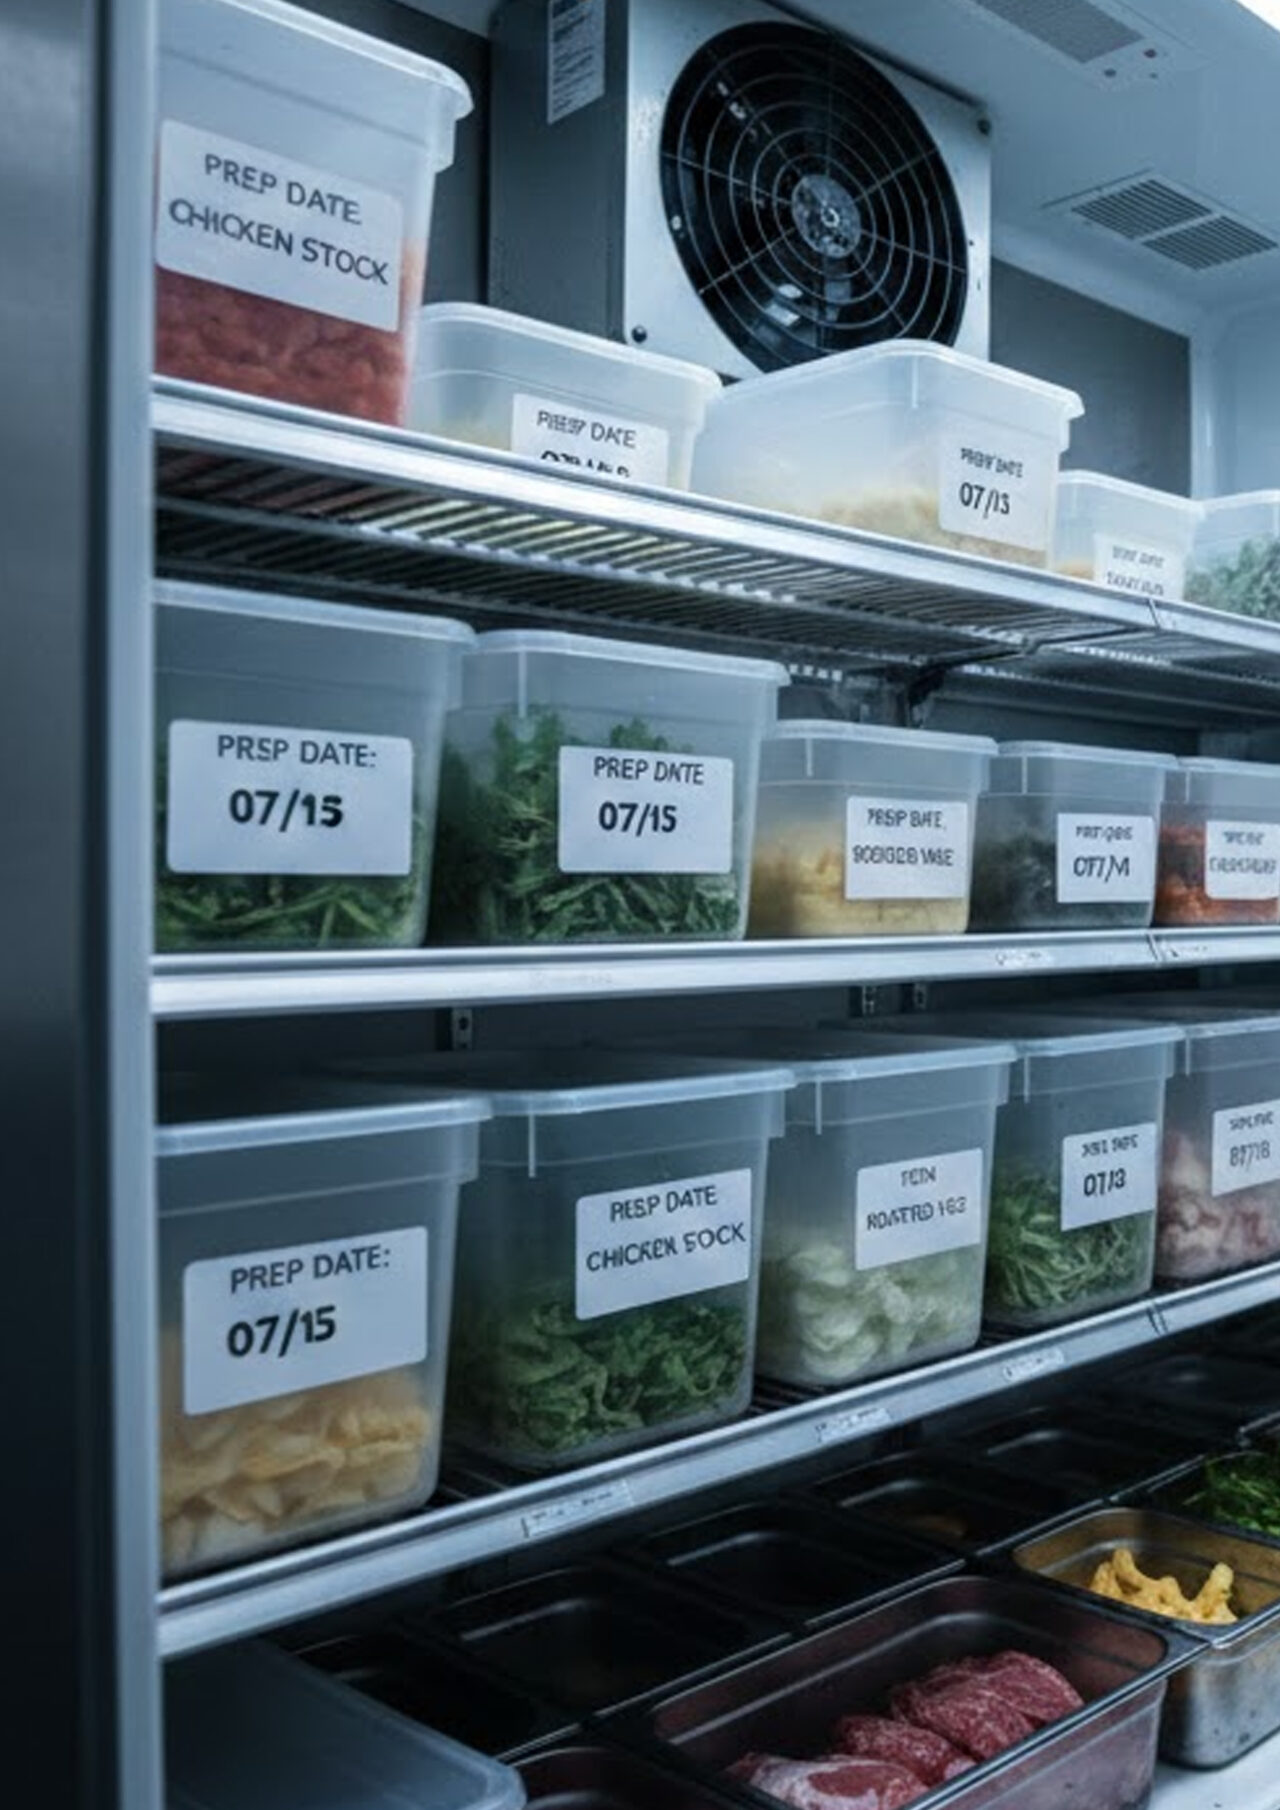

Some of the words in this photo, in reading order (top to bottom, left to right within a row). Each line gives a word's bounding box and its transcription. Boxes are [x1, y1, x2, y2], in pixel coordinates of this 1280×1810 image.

[204, 153, 277, 194] PREP
[286, 181, 362, 225] DATE
[594, 756, 649, 780] PREP
[229, 788, 344, 833] 07/15
[599, 801, 677, 837] 07/15
[666, 1185, 718, 1214] DATE
[231, 1258, 304, 1294] PREP
[313, 1244, 390, 1279] DATE:
[226, 1305, 336, 1358] 07/15
